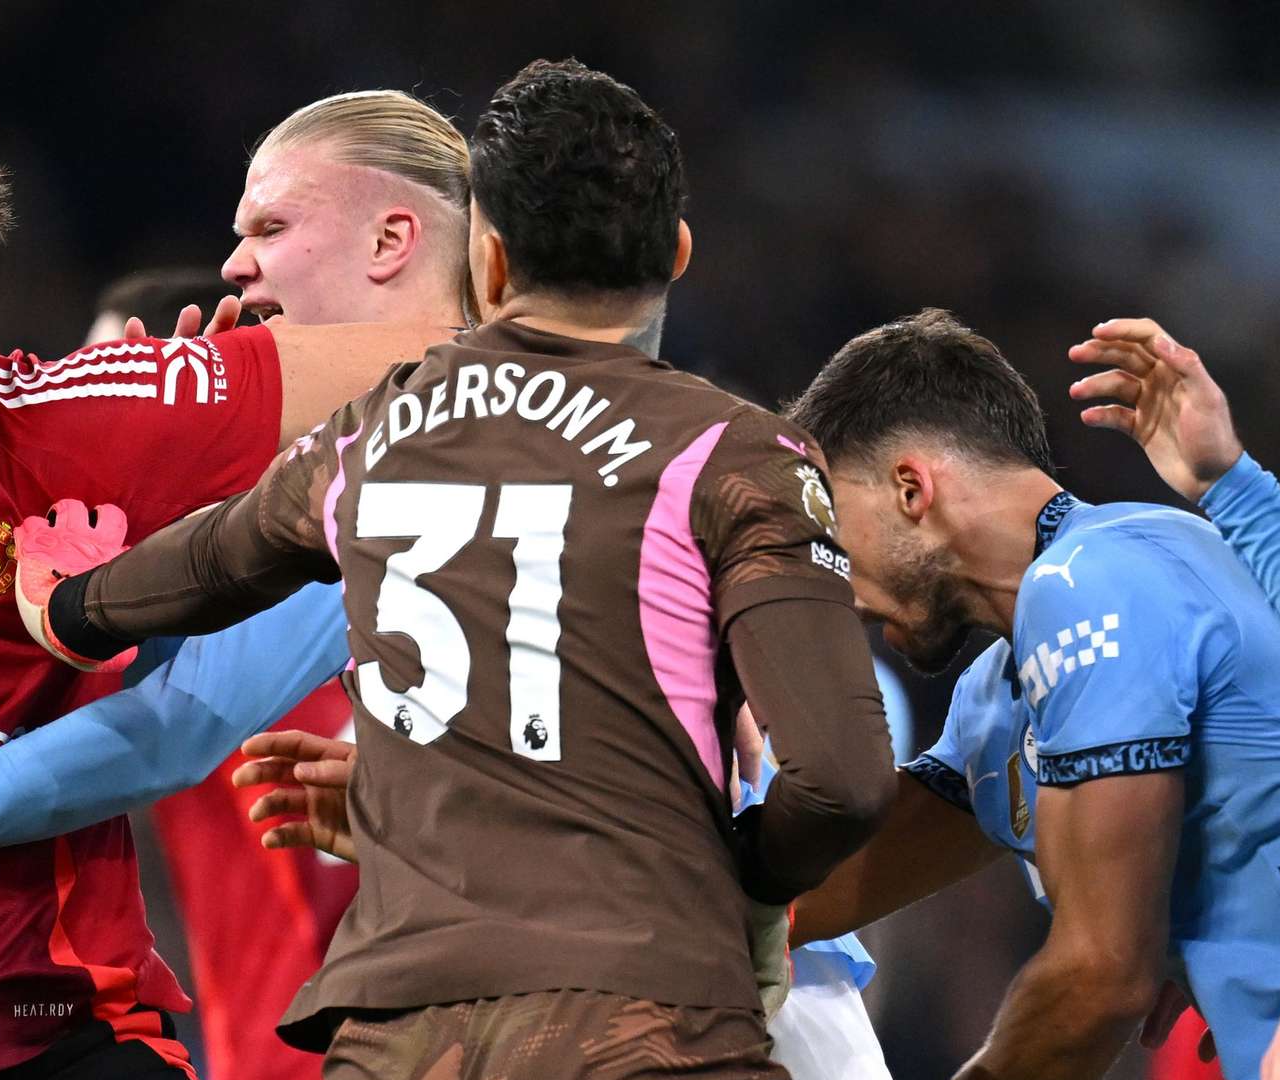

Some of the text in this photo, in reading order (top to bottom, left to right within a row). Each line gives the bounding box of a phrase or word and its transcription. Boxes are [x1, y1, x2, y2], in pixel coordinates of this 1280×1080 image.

[365, 363, 652, 487] EDERSON M.
[356, 481, 573, 762] 31
[14, 1003, 74, 1018] HEAT.RDY
